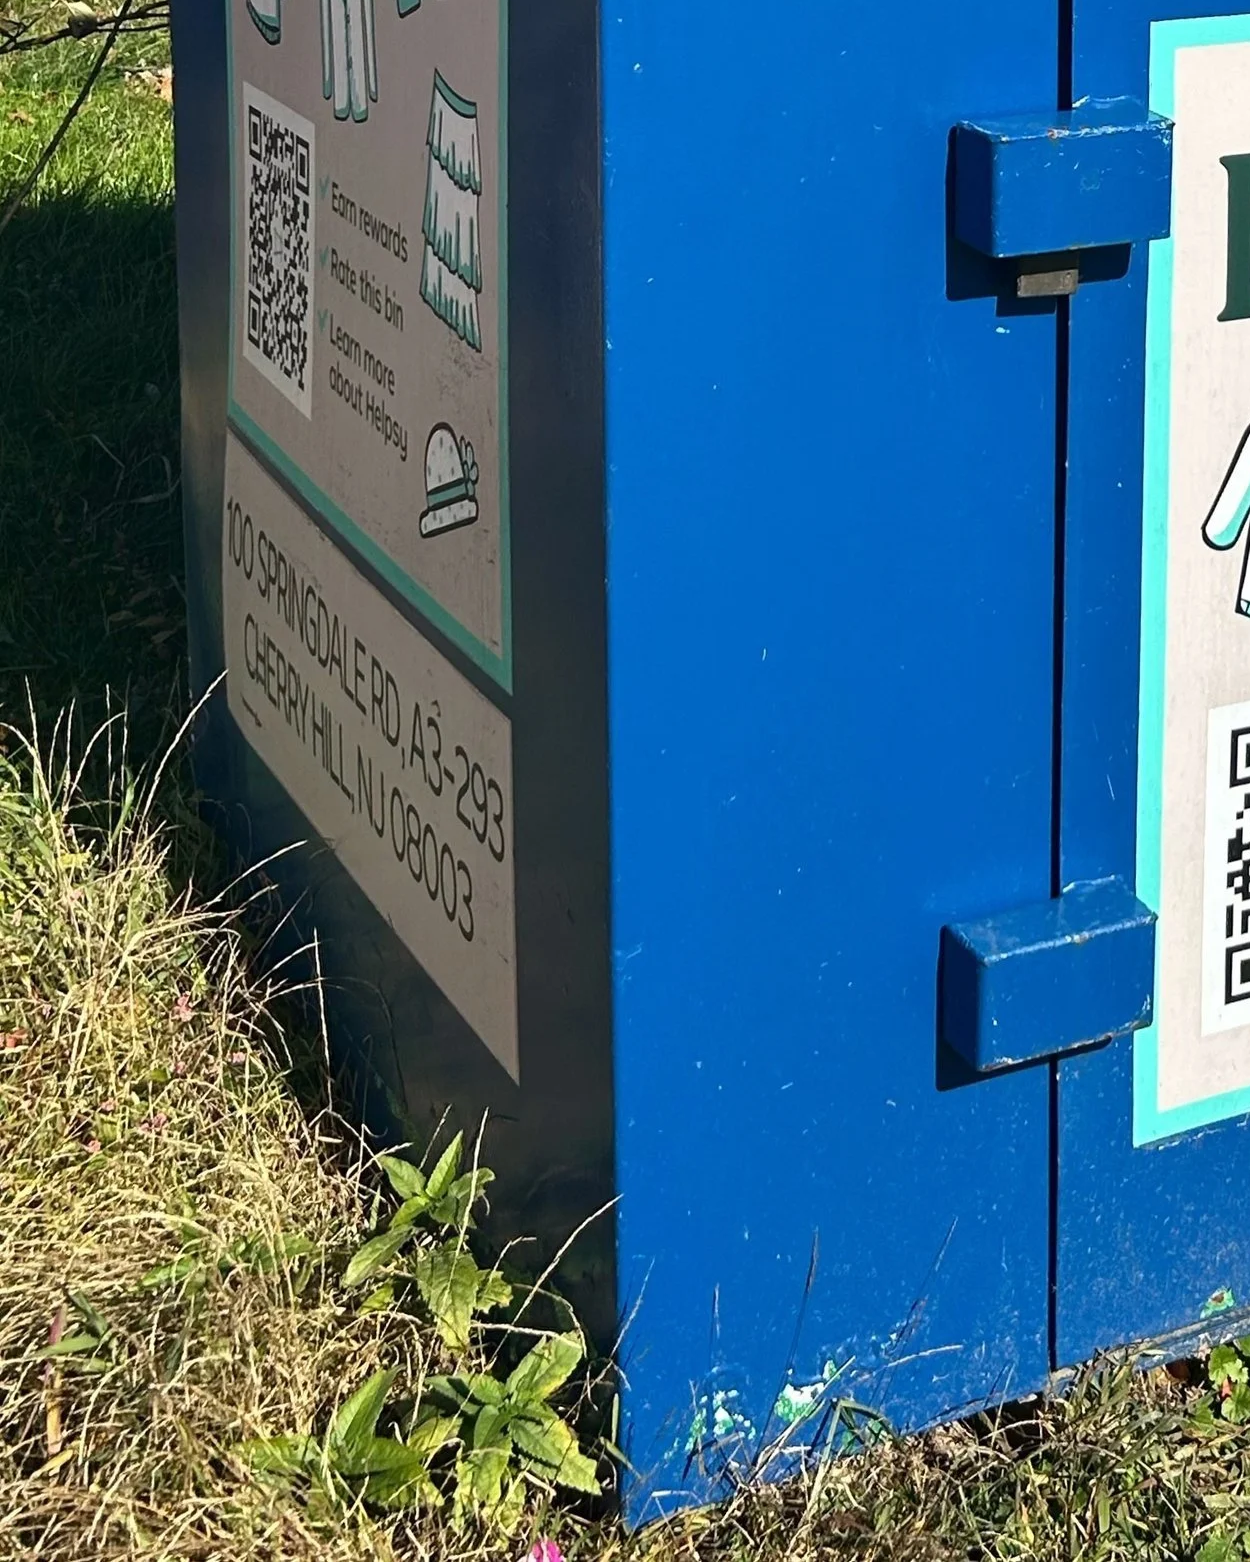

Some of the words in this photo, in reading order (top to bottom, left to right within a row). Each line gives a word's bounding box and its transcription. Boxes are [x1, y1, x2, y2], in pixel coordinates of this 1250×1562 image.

[331, 181, 357, 227] Earn
[359, 206, 408, 263] rewards
[331, 247, 356, 295] Rate
[360, 269, 381, 315] this
[385, 284, 404, 333] bin
[329, 313, 361, 367] Learn
[364, 348, 396, 396] more
[329, 360, 363, 416] about
[366, 389, 408, 463] Helpsy
[227, 495, 254, 581] 100
[257, 529, 366, 716] SPRINGDALE
[410, 701, 505, 863] A3-293
[244, 612, 310, 744] CHERRY
[357, 744, 385, 839] NJ
[390, 786, 474, 942] 08003
